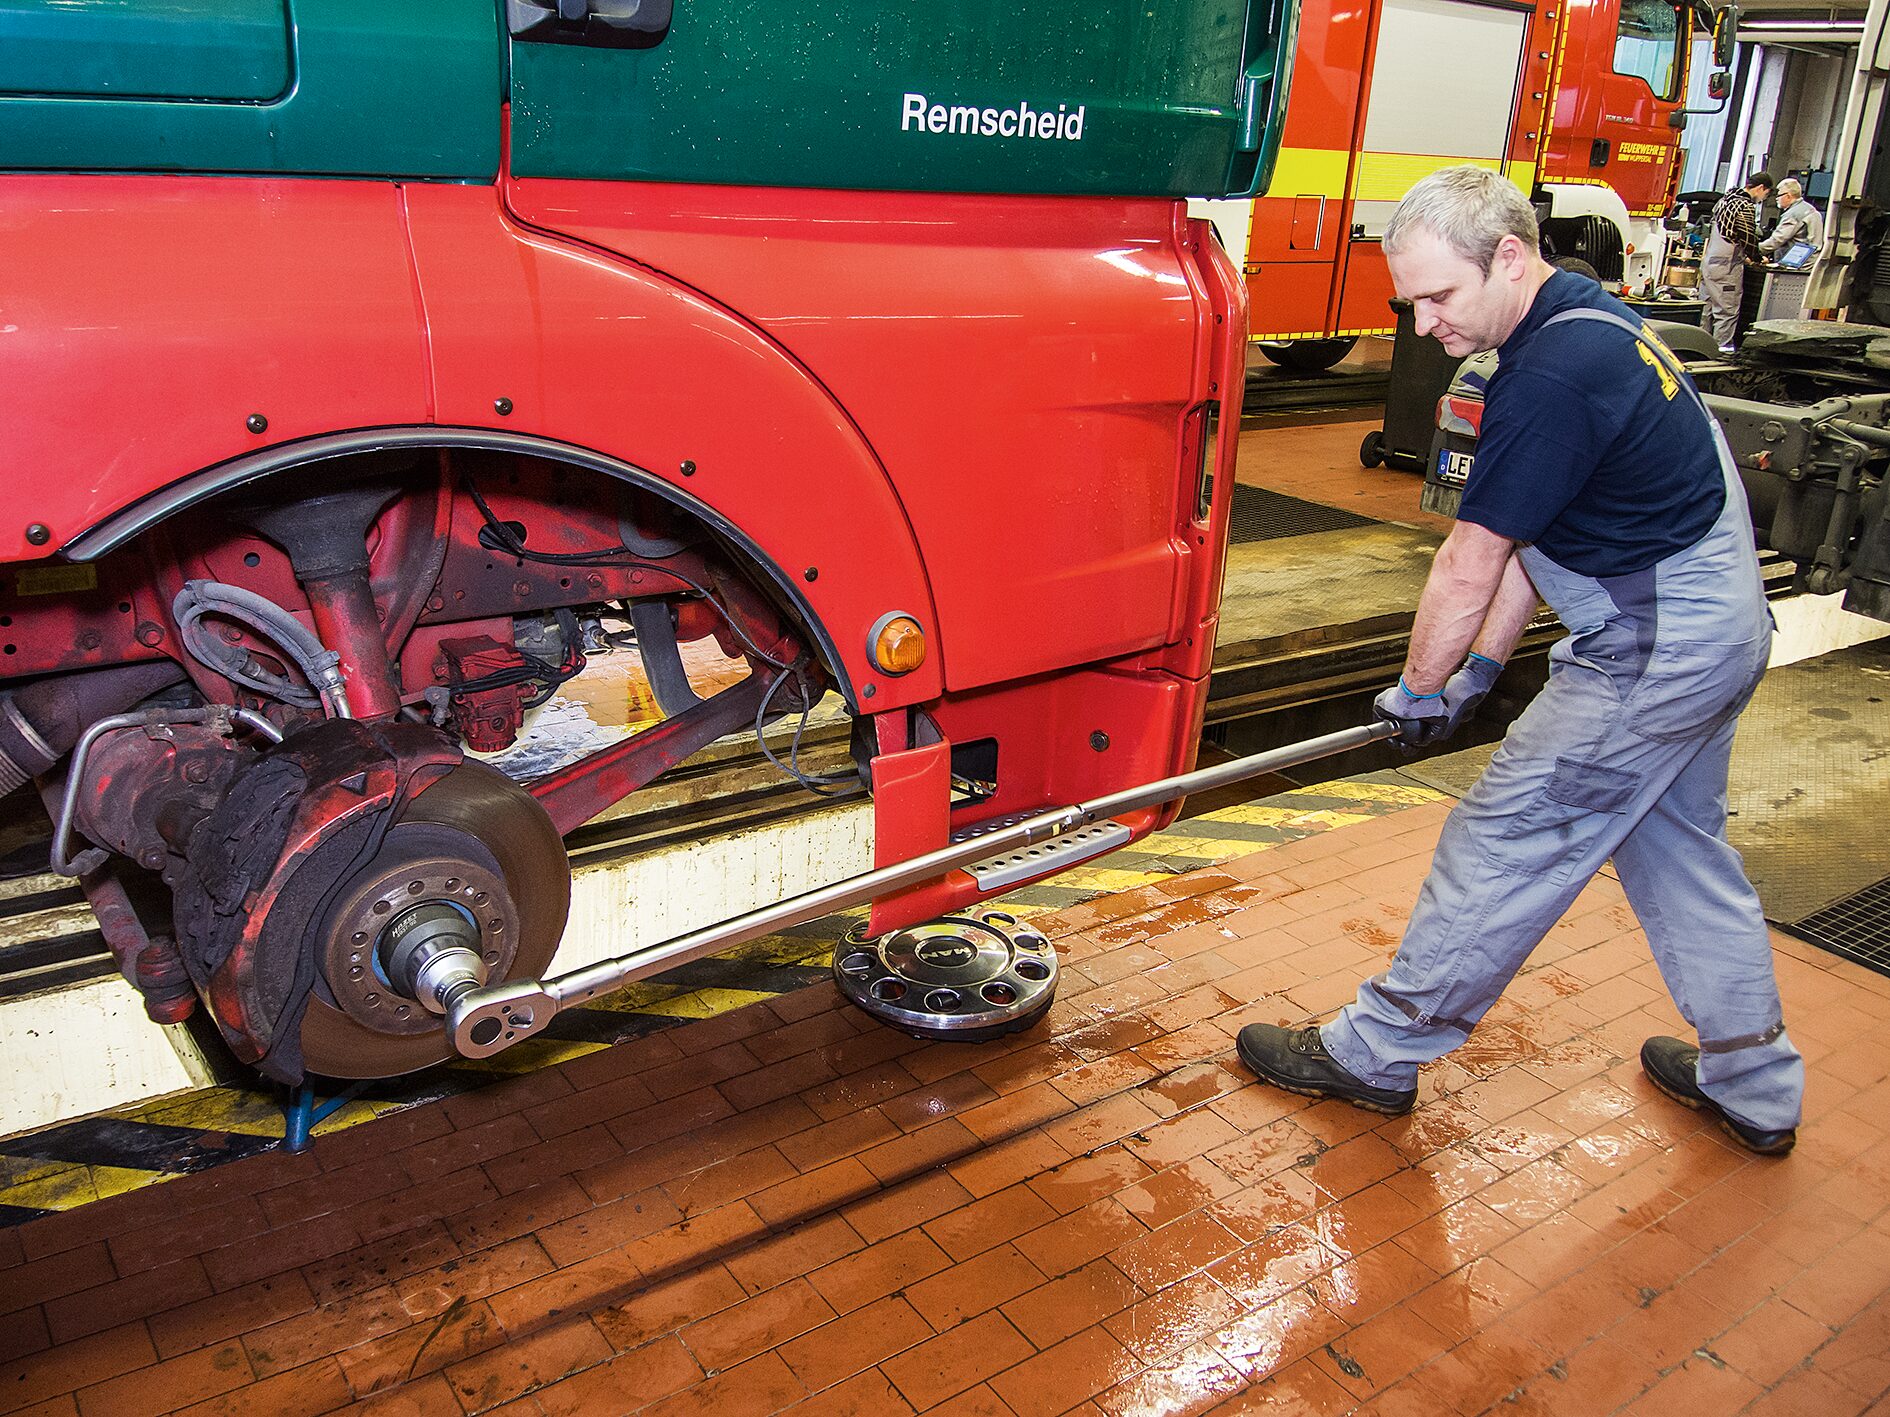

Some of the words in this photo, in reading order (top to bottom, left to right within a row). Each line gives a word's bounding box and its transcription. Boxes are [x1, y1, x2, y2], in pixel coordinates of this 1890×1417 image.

[901, 93, 1086, 141] Remscheid
[1619, 142, 1660, 156] FEUERWEHR
[391, 912, 418, 938] HAZET
[920, 946, 973, 960] MAN
